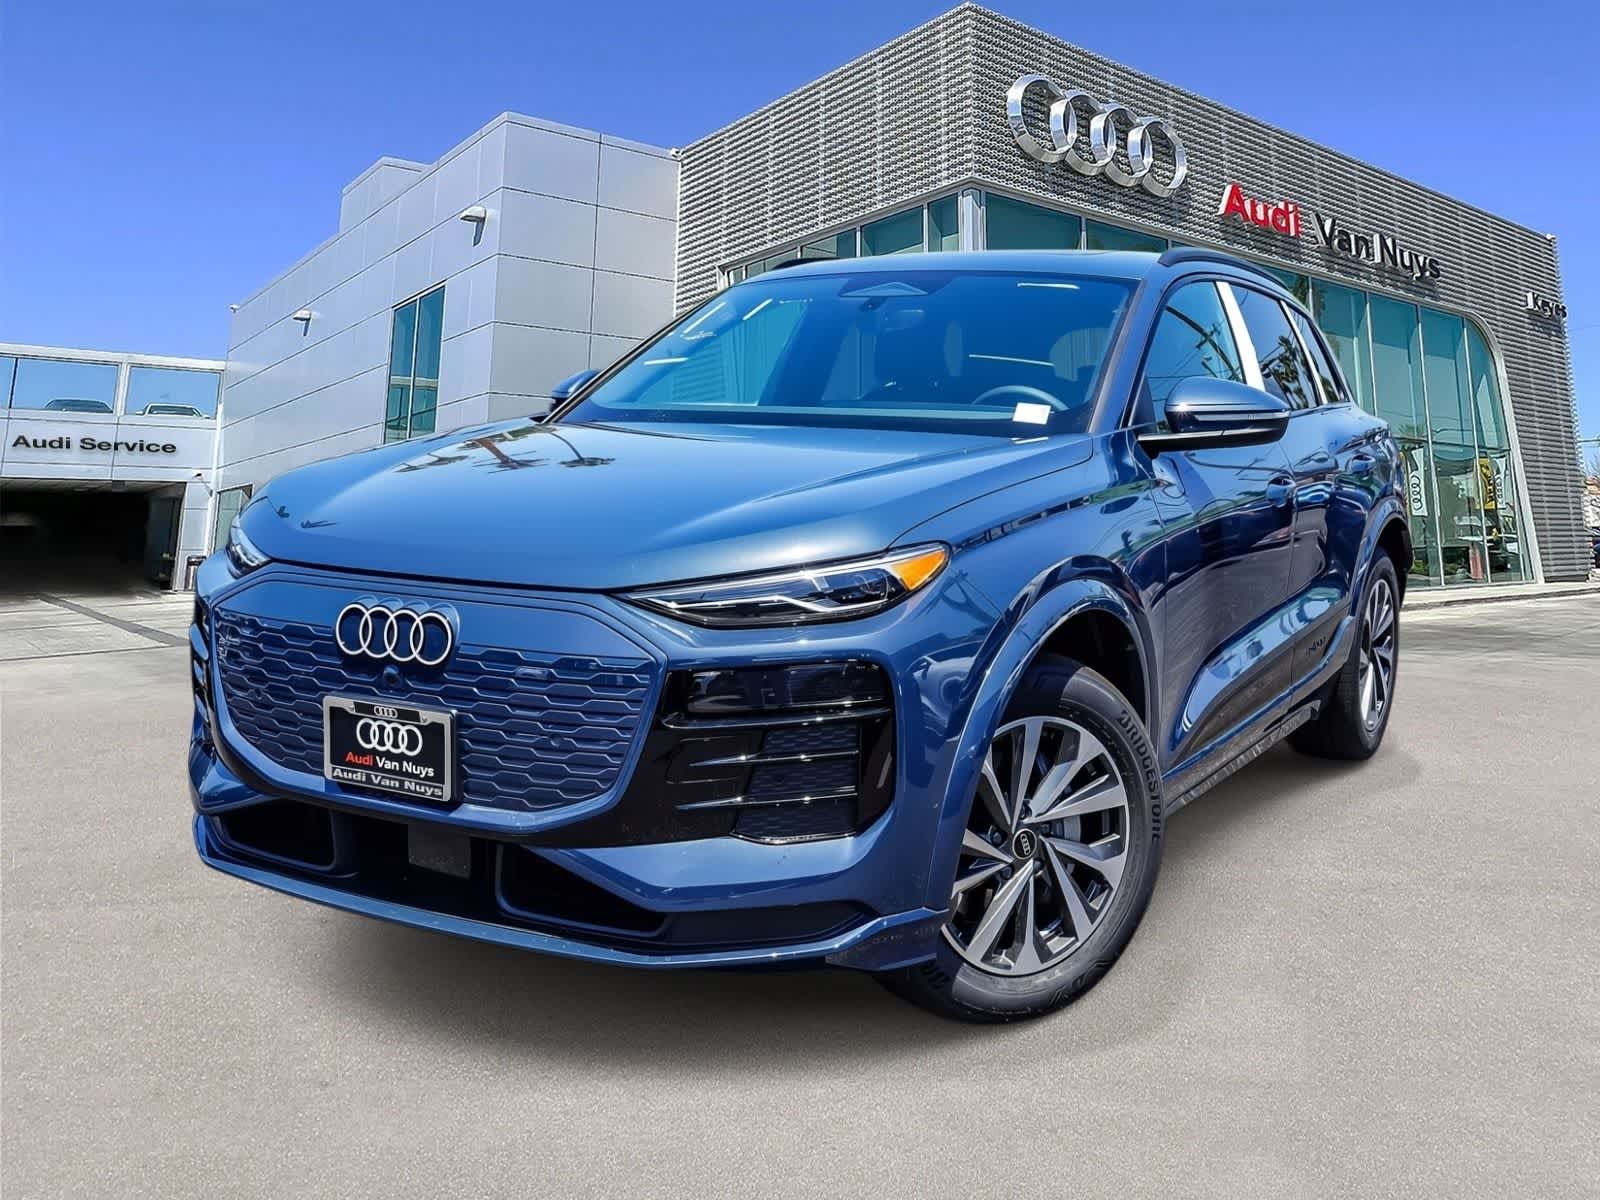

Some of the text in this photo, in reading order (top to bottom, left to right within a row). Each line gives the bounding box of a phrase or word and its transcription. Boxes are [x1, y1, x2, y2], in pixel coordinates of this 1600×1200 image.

[1218, 183, 1440, 280] Audi Van Nuys
[12, 435, 177, 453] Audi Service
[345, 751, 435, 778] Audi Van Nuys
[333, 768, 443, 796] Audi Van Nuys
